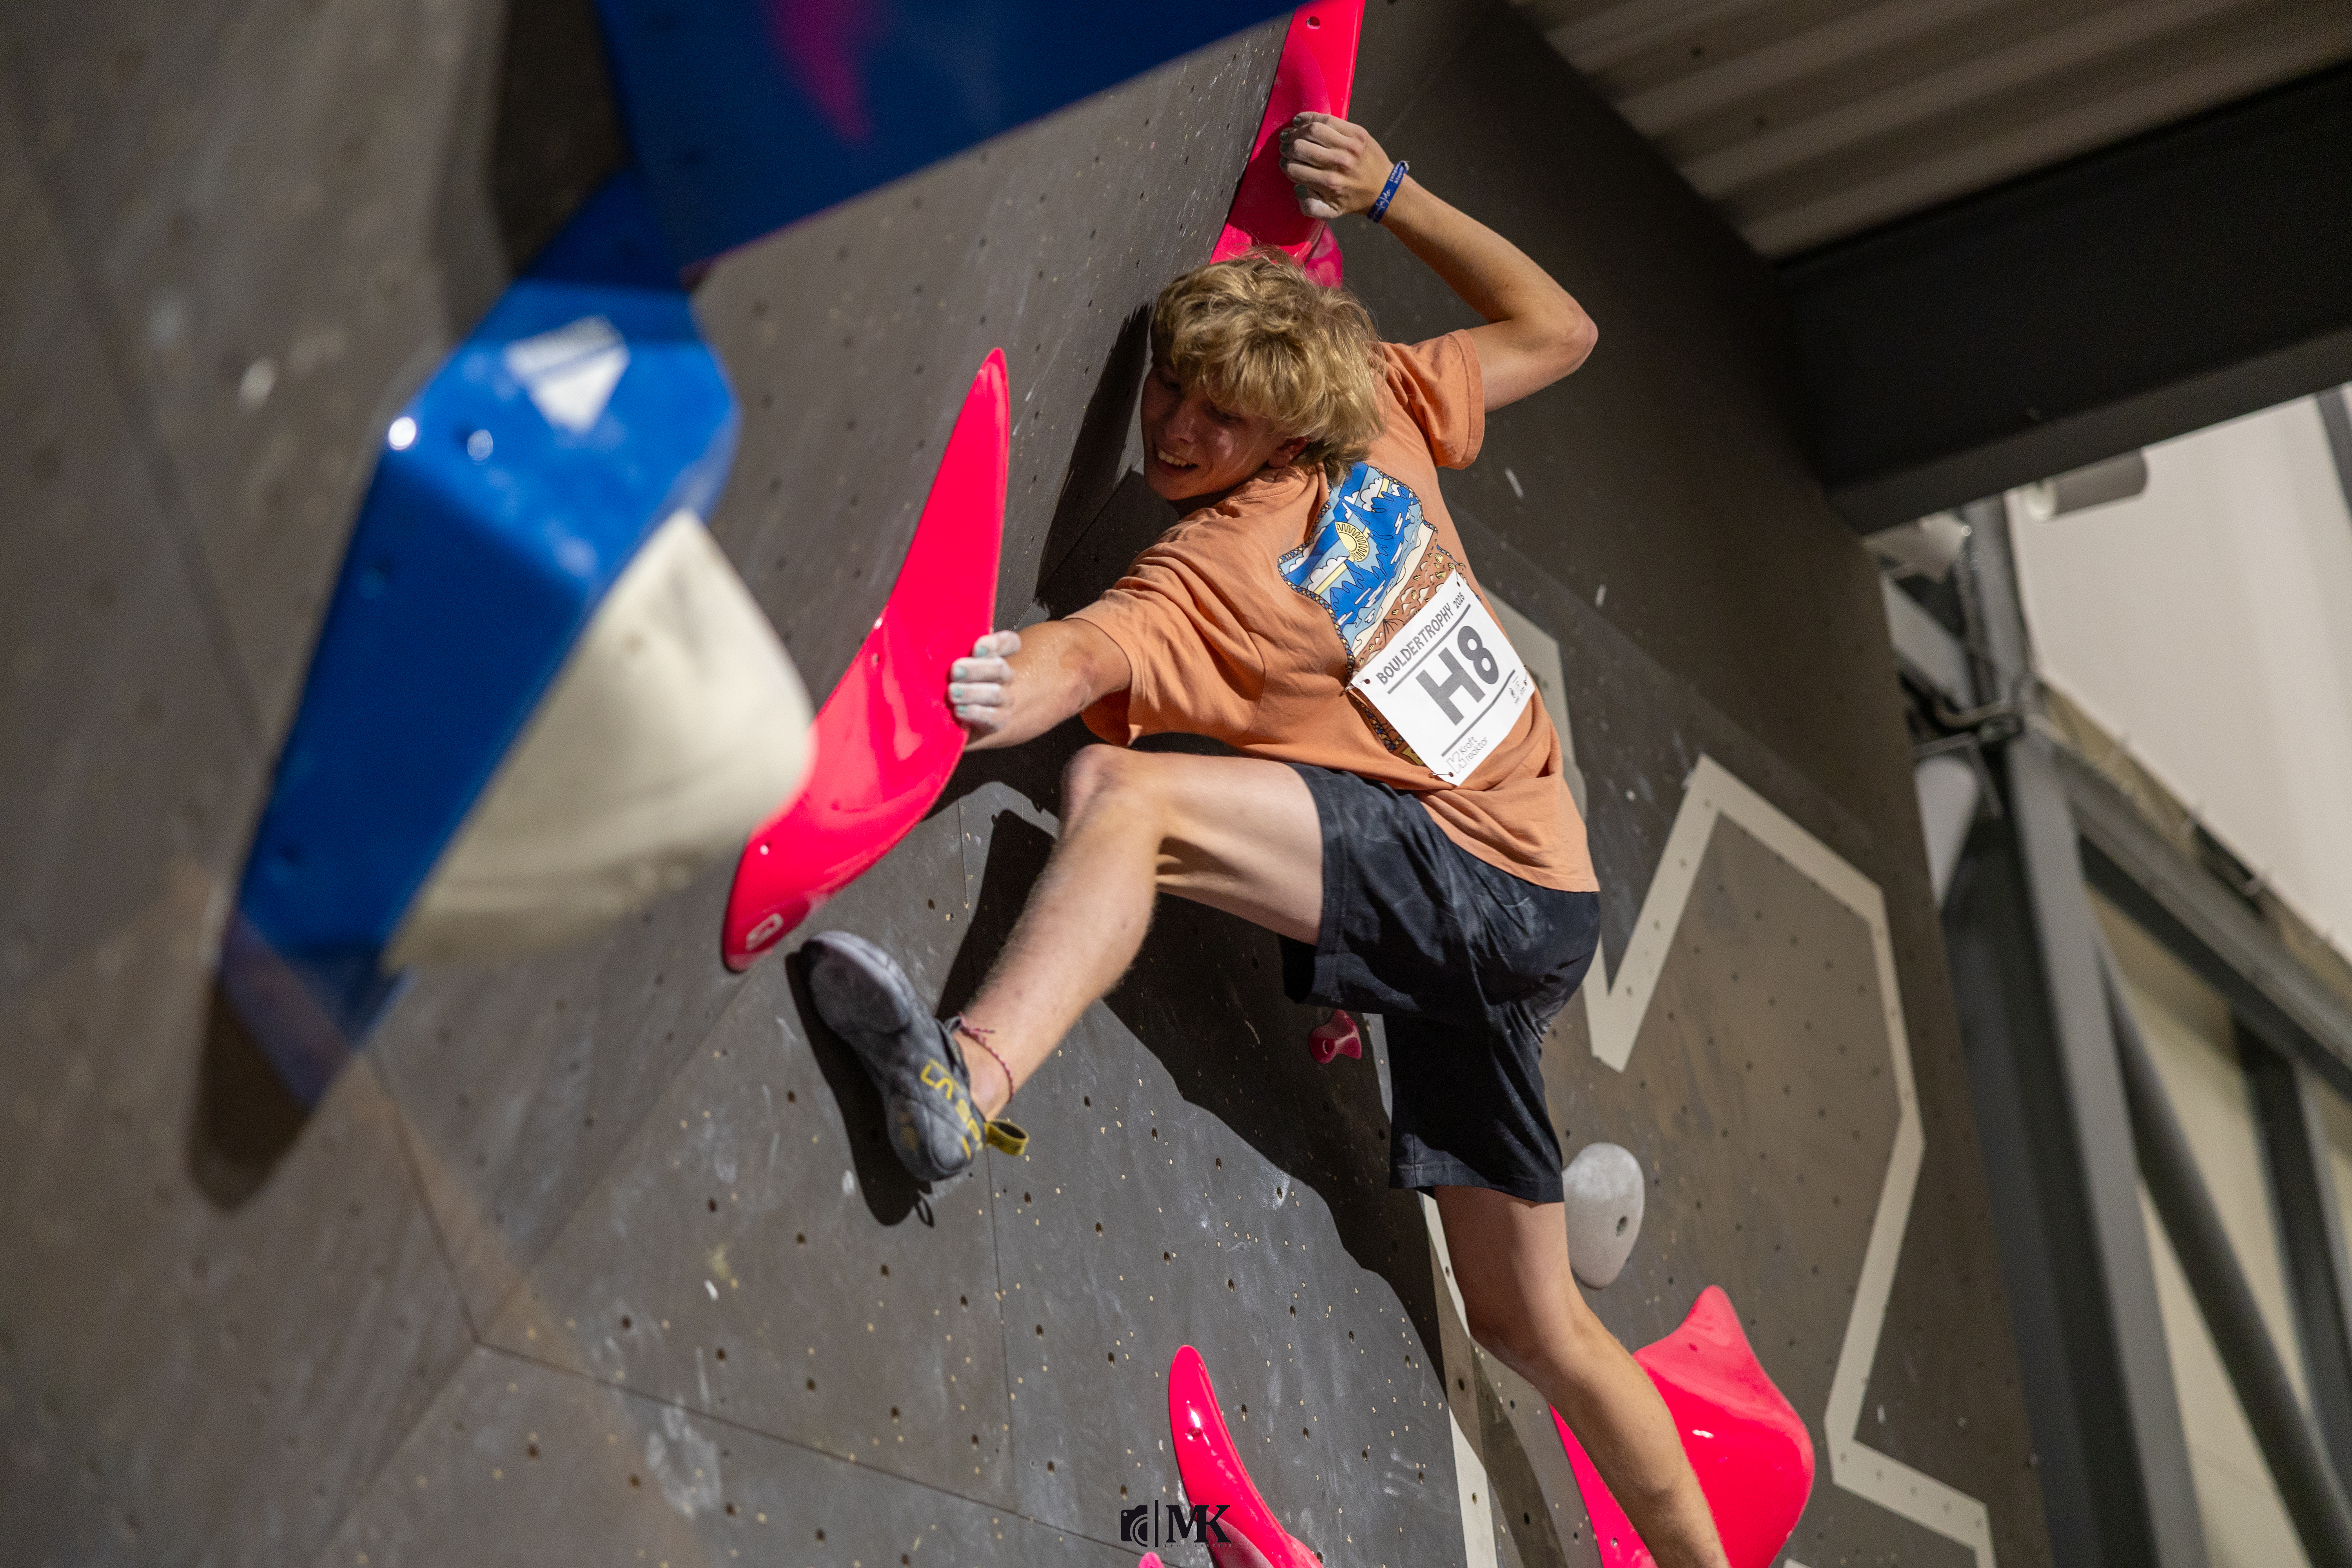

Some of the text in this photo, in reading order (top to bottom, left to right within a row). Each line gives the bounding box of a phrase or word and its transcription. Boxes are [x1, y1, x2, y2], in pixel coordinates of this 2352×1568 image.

[1376, 592, 1465, 685] BOULDERTROPHY 2025
[1415, 626, 1499, 726] H8
[1458, 737, 1477, 755] Kraft
[1465, 737, 1488, 762] reaktor
